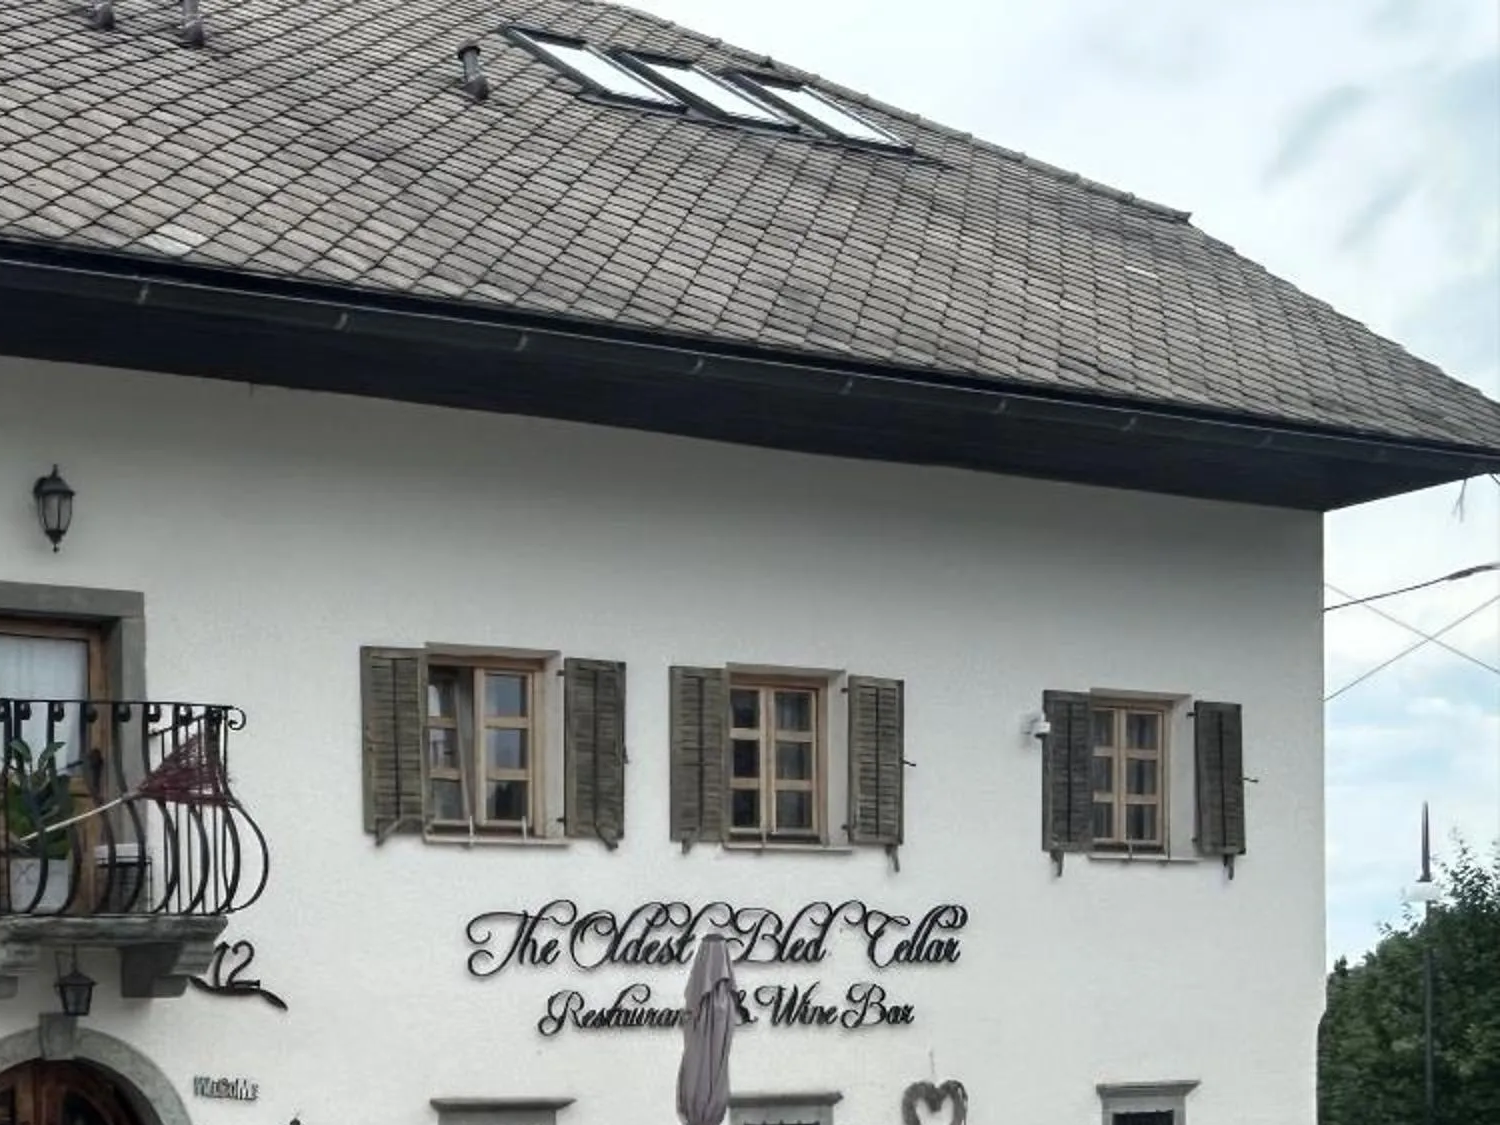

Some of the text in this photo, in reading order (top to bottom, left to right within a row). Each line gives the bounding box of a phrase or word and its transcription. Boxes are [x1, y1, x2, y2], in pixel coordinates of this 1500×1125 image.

[212, 940, 261, 990] 12
[465, 899, 969, 977] The Oldest Bled Cellar
[538, 983, 687, 1037] Restauran
[753, 981, 839, 1027] Wine
[840, 982, 915, 1030] Bar
